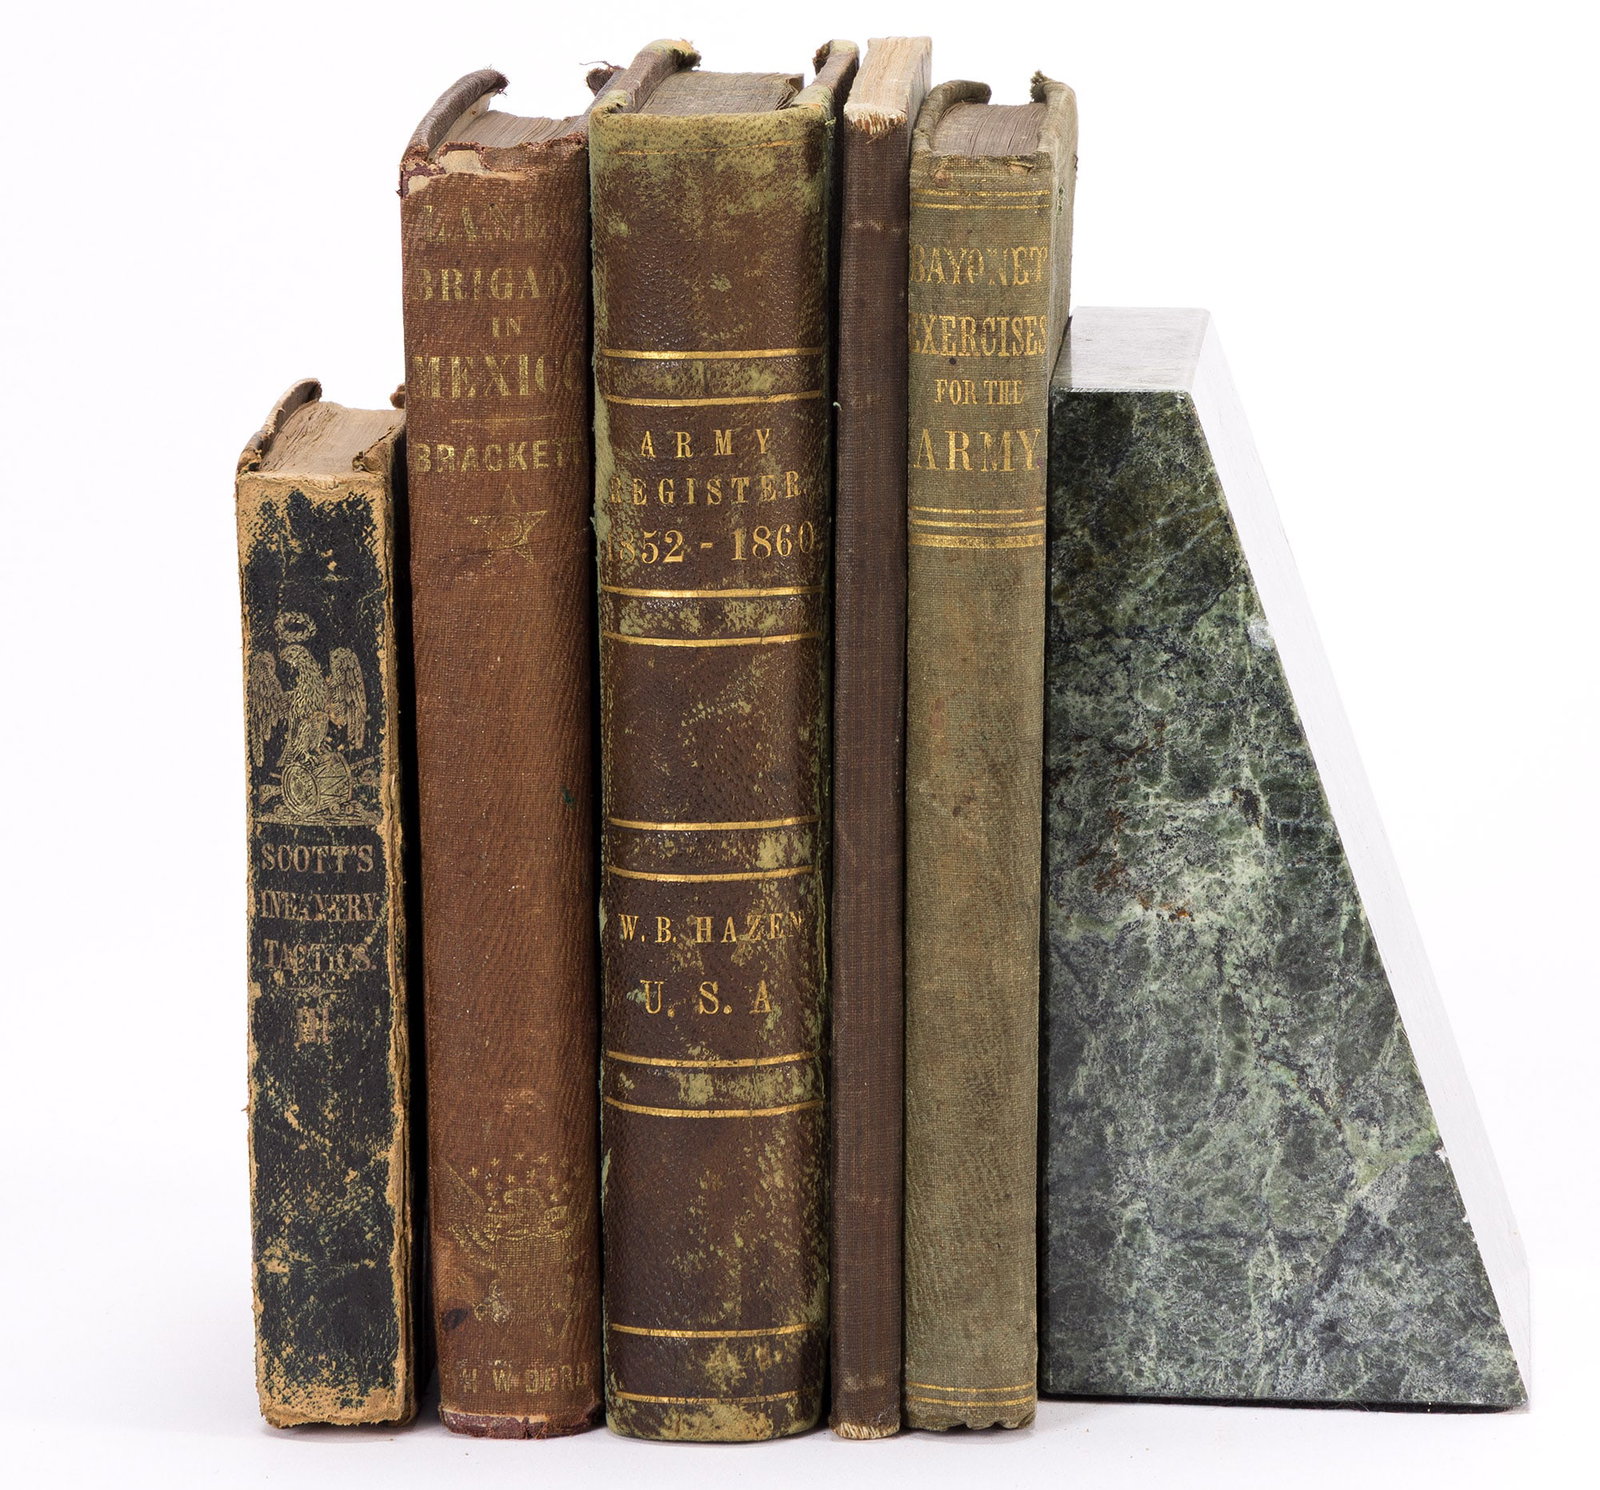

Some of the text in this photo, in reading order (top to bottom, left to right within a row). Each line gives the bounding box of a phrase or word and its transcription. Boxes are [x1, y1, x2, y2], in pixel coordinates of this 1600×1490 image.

[491, 316, 521, 338] IN
[908, 314, 1048, 357] EXERCISES
[933, 379, 1025, 405] FOR THE
[640, 428, 773, 459] ARMY
[913, 428, 1042, 473] ARMY
[731, 520, 815, 561] 1860
[261, 843, 376, 875] SCOTT'S
[694, 910, 804, 944] HAZEN
